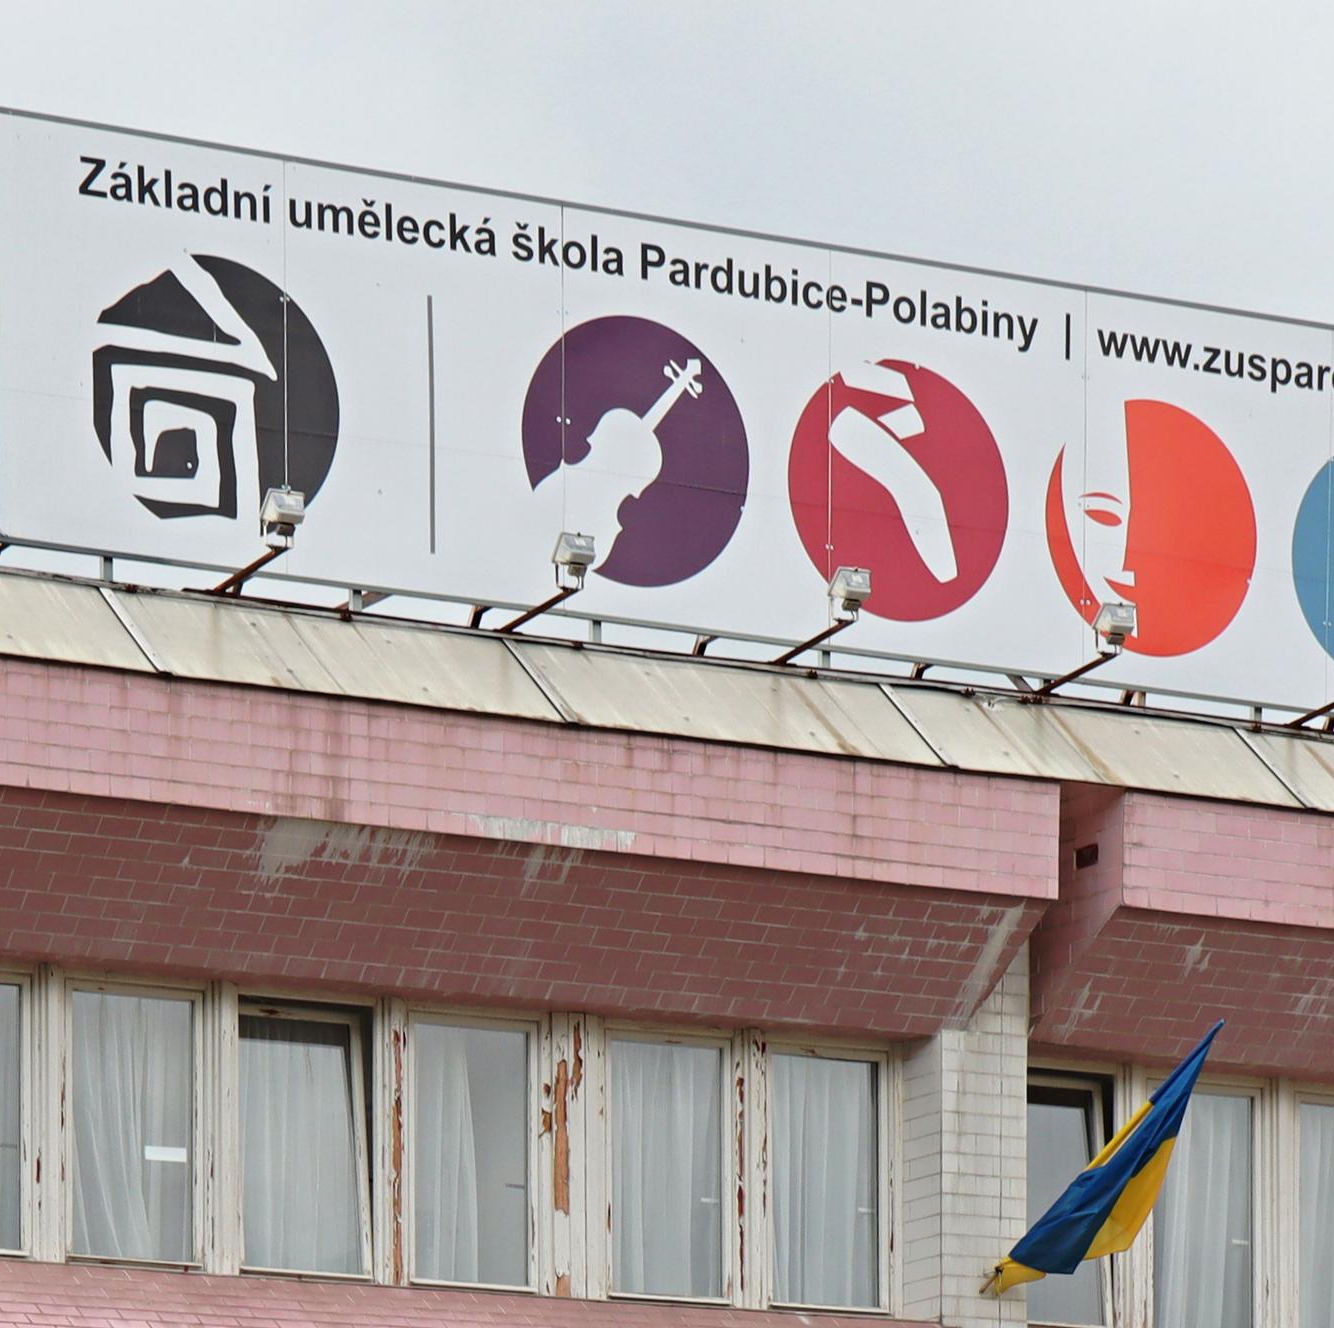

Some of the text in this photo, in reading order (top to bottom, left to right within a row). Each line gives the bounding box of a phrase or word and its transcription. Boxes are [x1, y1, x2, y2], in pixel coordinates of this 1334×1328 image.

[77, 154, 272, 225] Základní
[288, 197, 497, 258] umělecká
[511, 221, 625, 277] škola
[639, 242, 1039, 352] Pardubice-Polabiny
